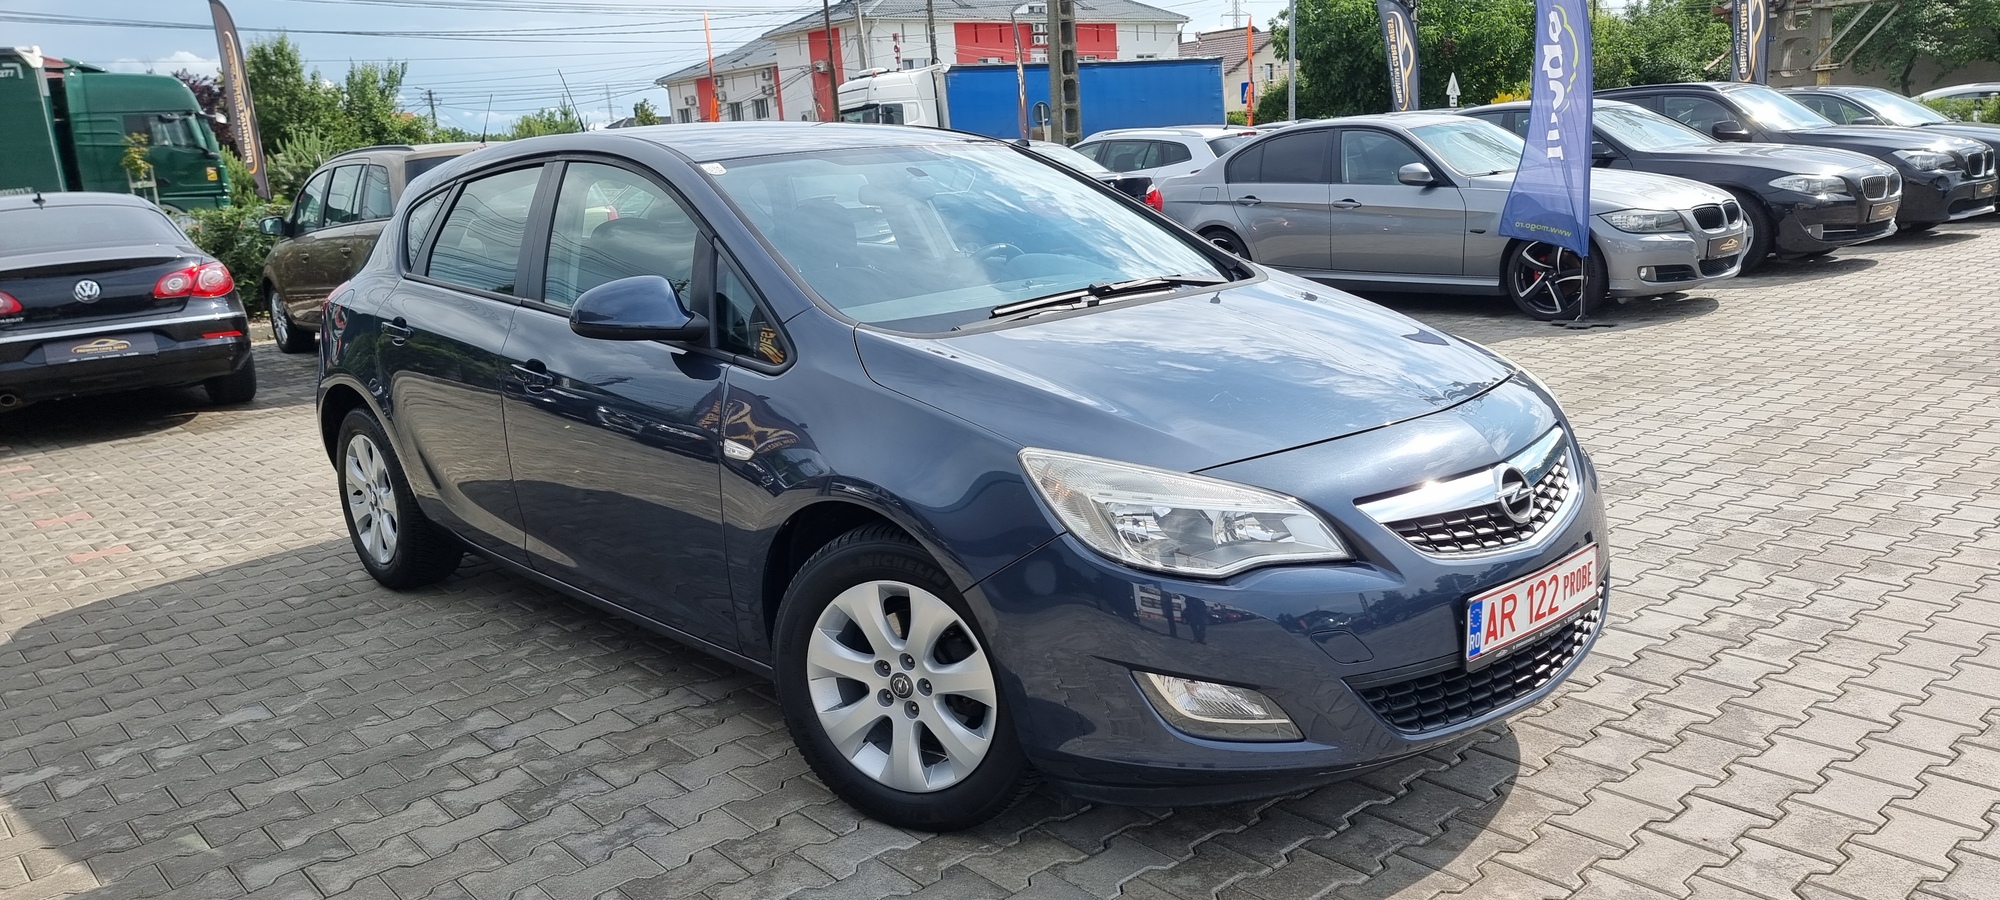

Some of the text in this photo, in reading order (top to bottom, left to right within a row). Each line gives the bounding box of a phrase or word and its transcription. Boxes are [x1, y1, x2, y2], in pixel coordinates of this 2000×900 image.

[858, 554, 948, 586] MICHELIN
[1484, 560, 1593, 646] AR 122 PROBE
[1469, 631, 1481, 652] RO
